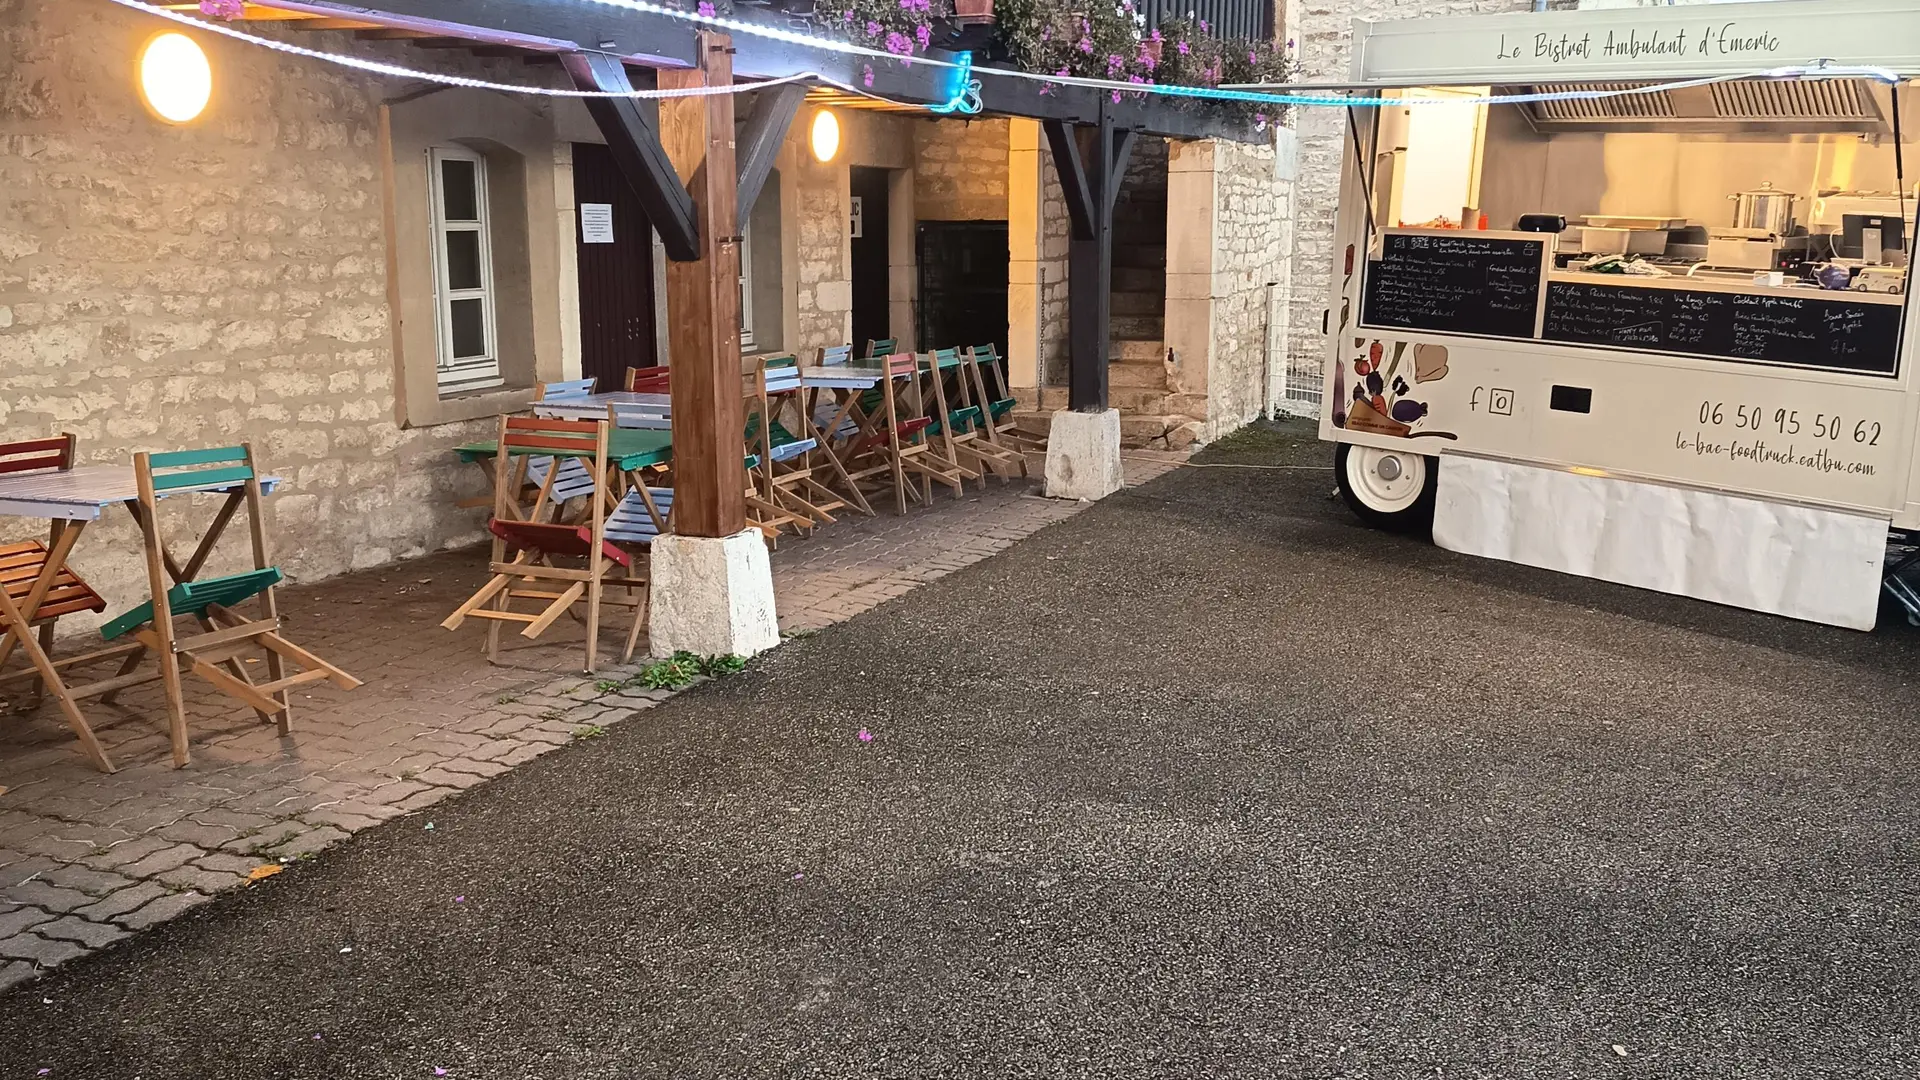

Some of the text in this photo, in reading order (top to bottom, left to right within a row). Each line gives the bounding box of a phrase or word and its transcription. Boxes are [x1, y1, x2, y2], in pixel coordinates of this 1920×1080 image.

[1497, 33, 1521, 59] Le
[1534, 32, 1591, 62] Bistrot
[1603, 28, 1687, 58] Ambulant
[850, 202, 859, 216] IC
[1699, 400, 1882, 446] 06 50 95 50 62
